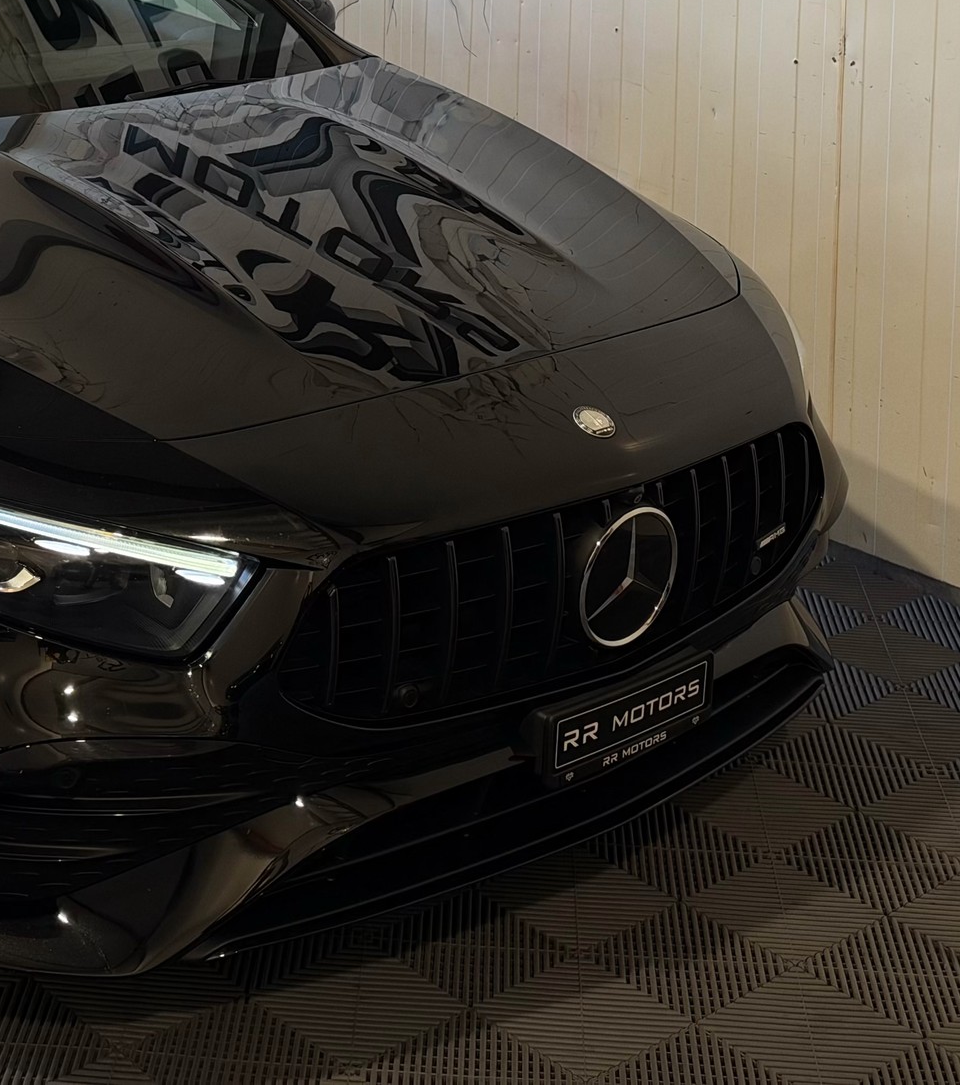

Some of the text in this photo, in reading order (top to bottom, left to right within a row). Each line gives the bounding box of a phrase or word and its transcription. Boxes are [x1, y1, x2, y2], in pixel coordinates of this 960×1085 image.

[563, 679, 700, 752] RR MOTORS
[602, 730, 667, 767] RR MOTORS
